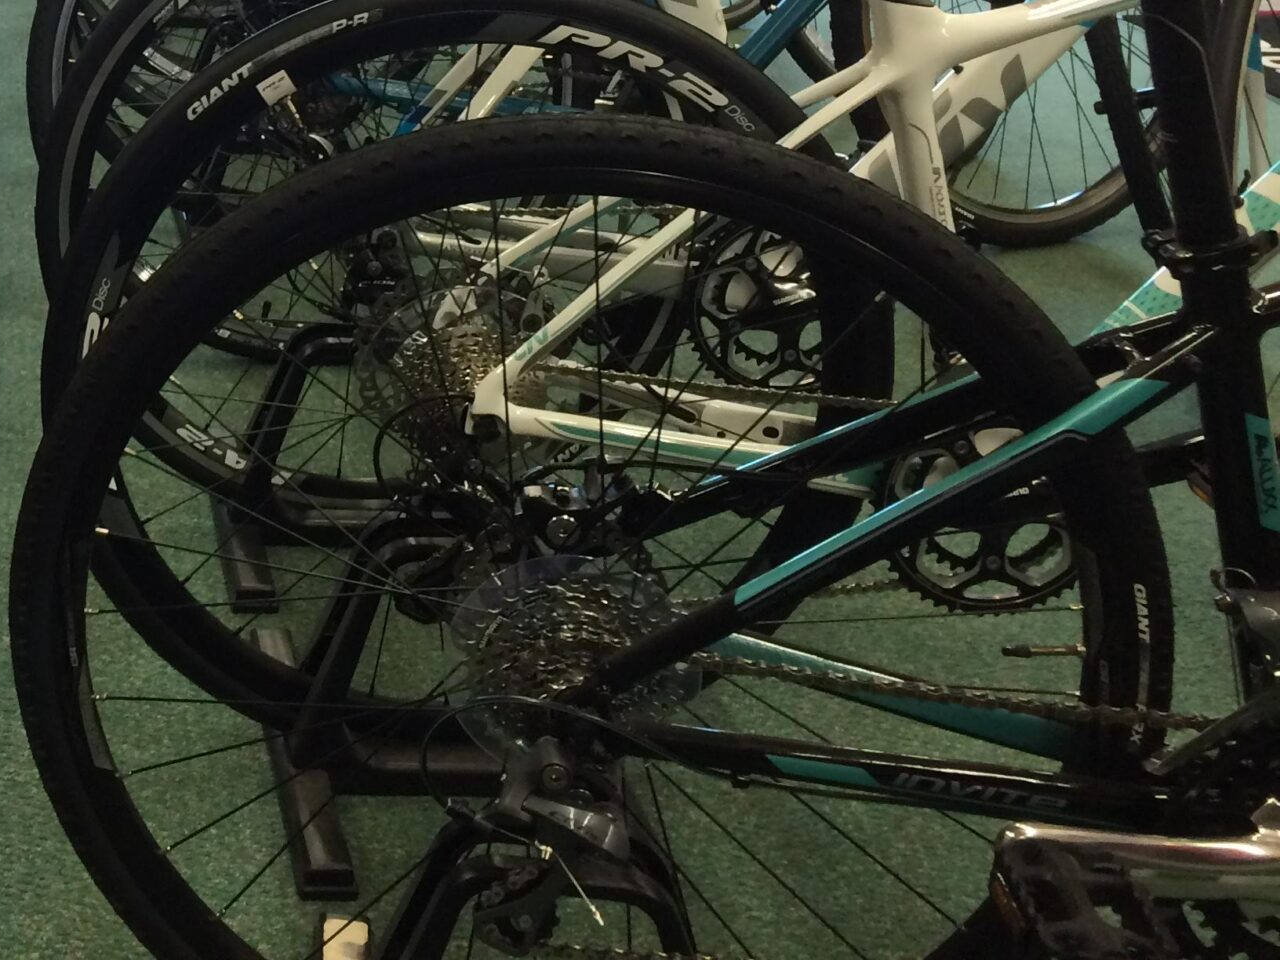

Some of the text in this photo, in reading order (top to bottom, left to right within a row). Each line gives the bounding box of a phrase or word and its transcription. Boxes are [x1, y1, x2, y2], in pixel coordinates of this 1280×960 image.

[186, 62, 253, 121] GIANT
[536, 24, 756, 132] PR-2 Disc
[91, 278, 111, 311] Disc
[1133, 582, 1151, 644] GIANT
